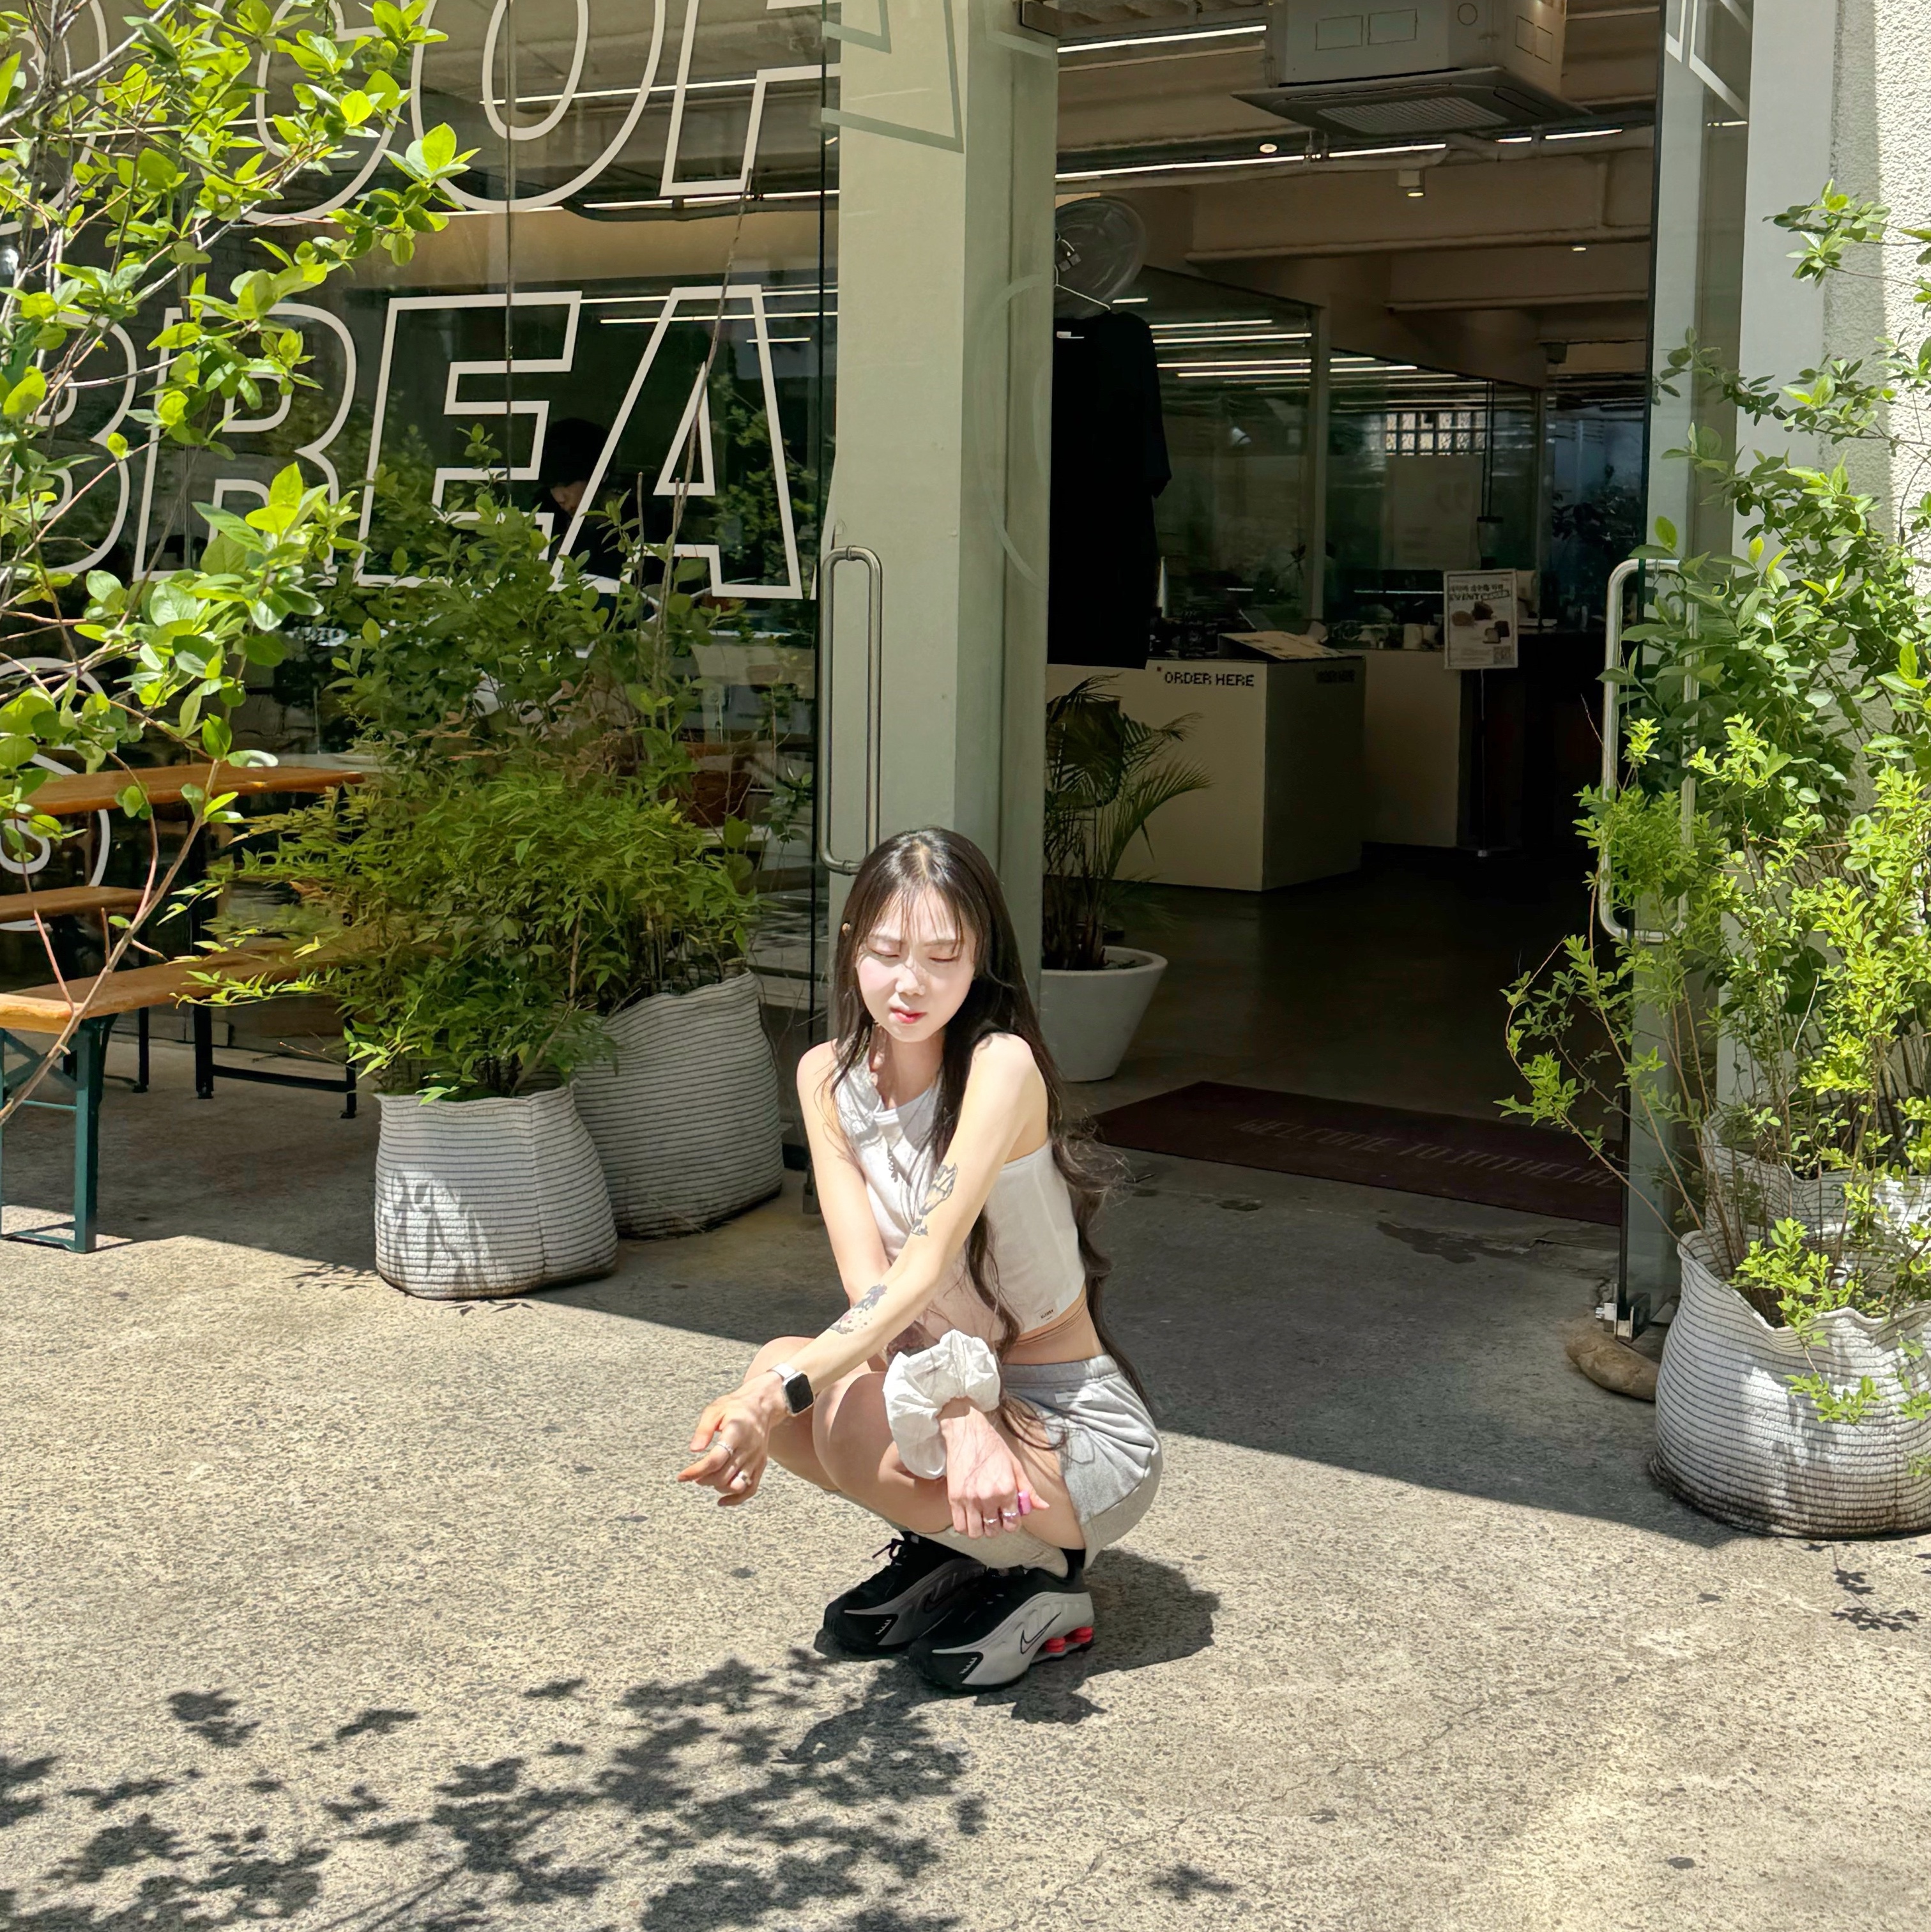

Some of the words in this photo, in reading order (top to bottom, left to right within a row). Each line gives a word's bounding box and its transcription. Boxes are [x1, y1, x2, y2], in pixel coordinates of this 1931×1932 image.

[0, 284, 834, 600] BREA
[1164, 671, 1212, 685] ORDER
[1215, 673, 1255, 687] HERE
[1233, 1119, 1401, 1153] WELCOME
[1397, 1143, 1451, 1160] TO
